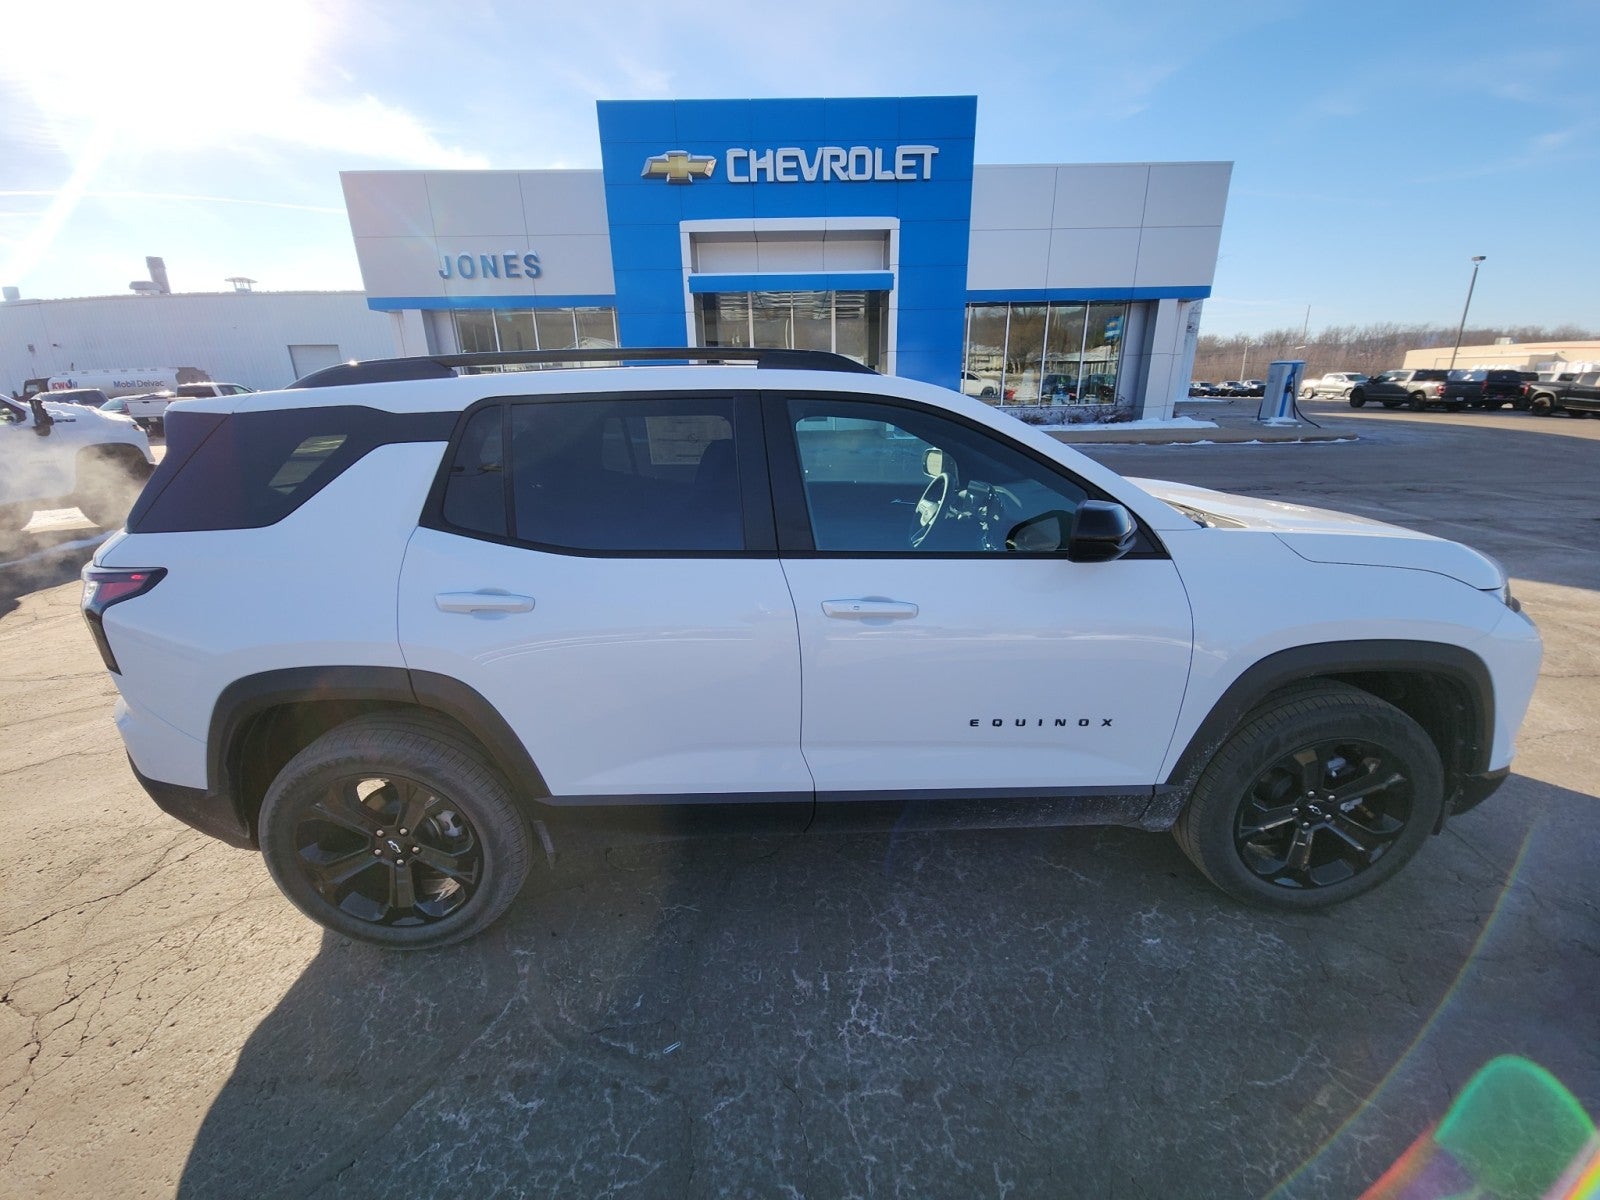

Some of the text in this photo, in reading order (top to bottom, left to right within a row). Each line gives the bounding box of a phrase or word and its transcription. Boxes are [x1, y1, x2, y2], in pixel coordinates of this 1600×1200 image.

[726, 145, 939, 182] CHEVROLET
[438, 251, 542, 279] JONES
[113, 380, 136, 389] Mobil
[969, 718, 1113, 728] EQUINOX
